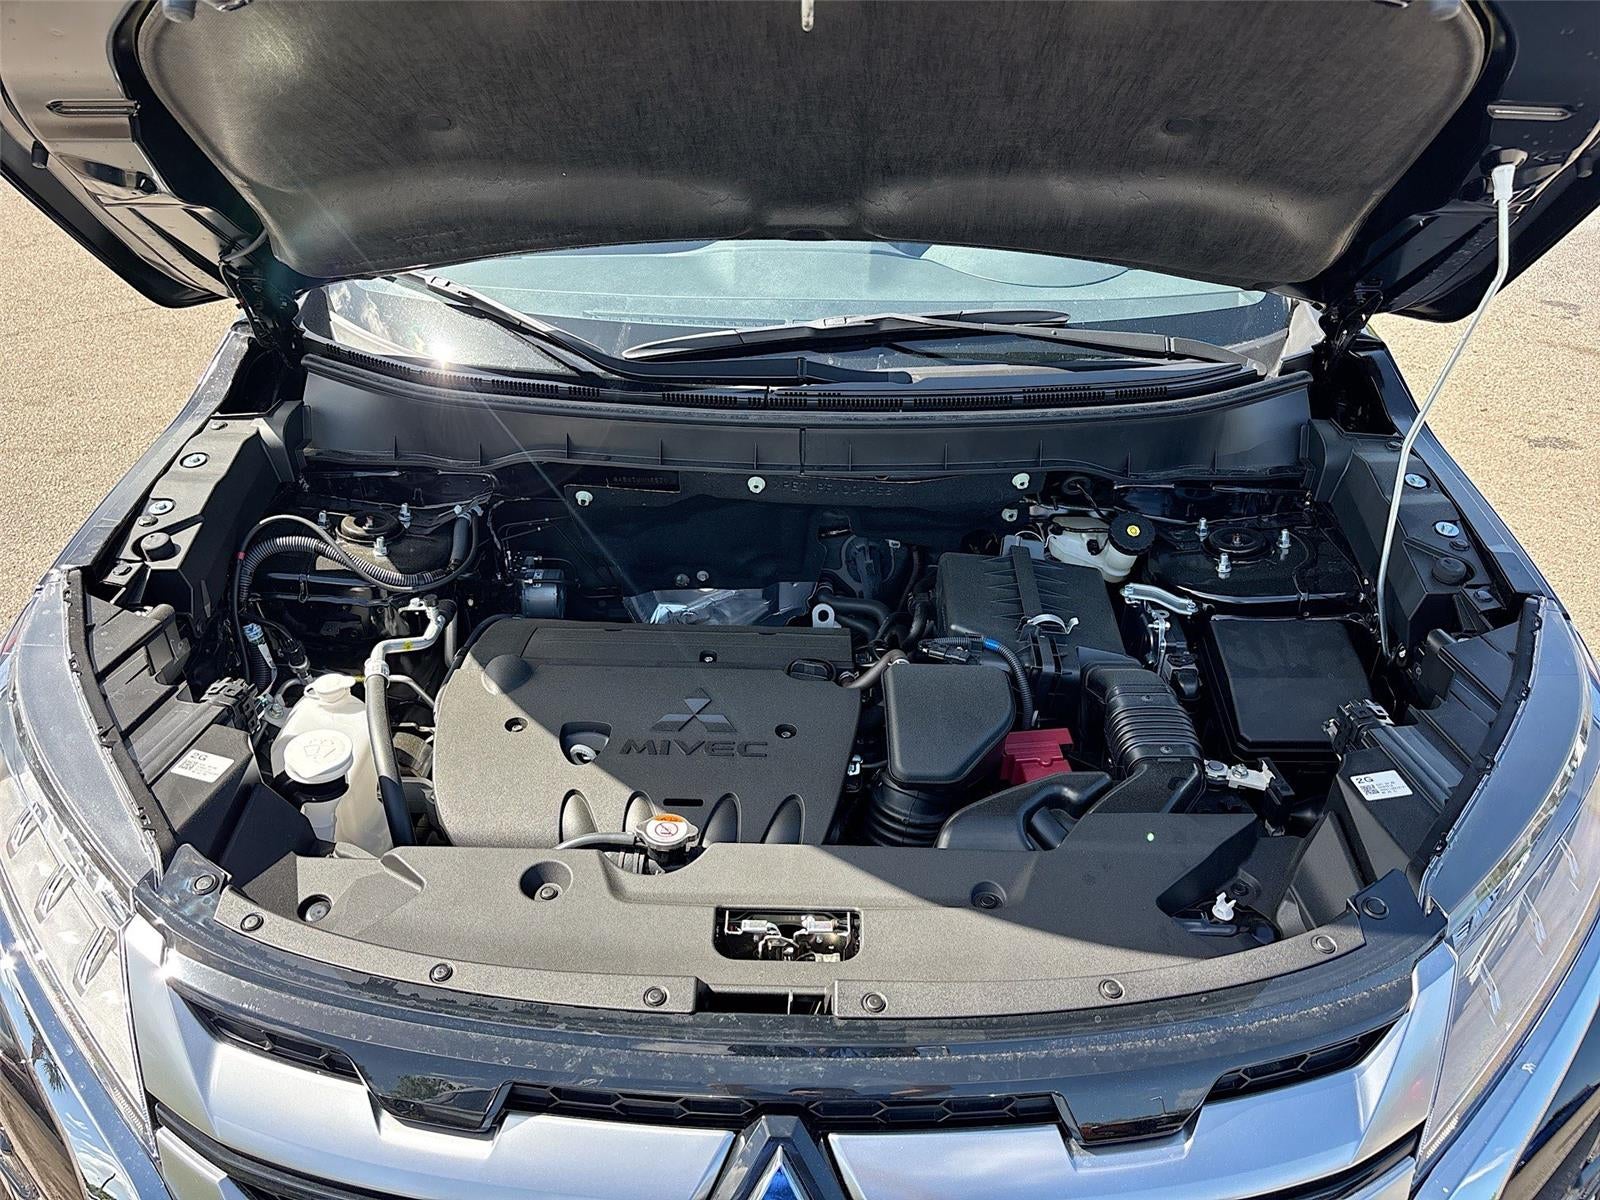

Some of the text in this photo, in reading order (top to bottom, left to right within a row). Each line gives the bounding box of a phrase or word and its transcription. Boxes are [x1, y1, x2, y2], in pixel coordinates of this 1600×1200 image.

[619, 739, 769, 758] MIVEC
[190, 752, 208, 761] 2G
[1355, 776, 1374, 784] 2G
